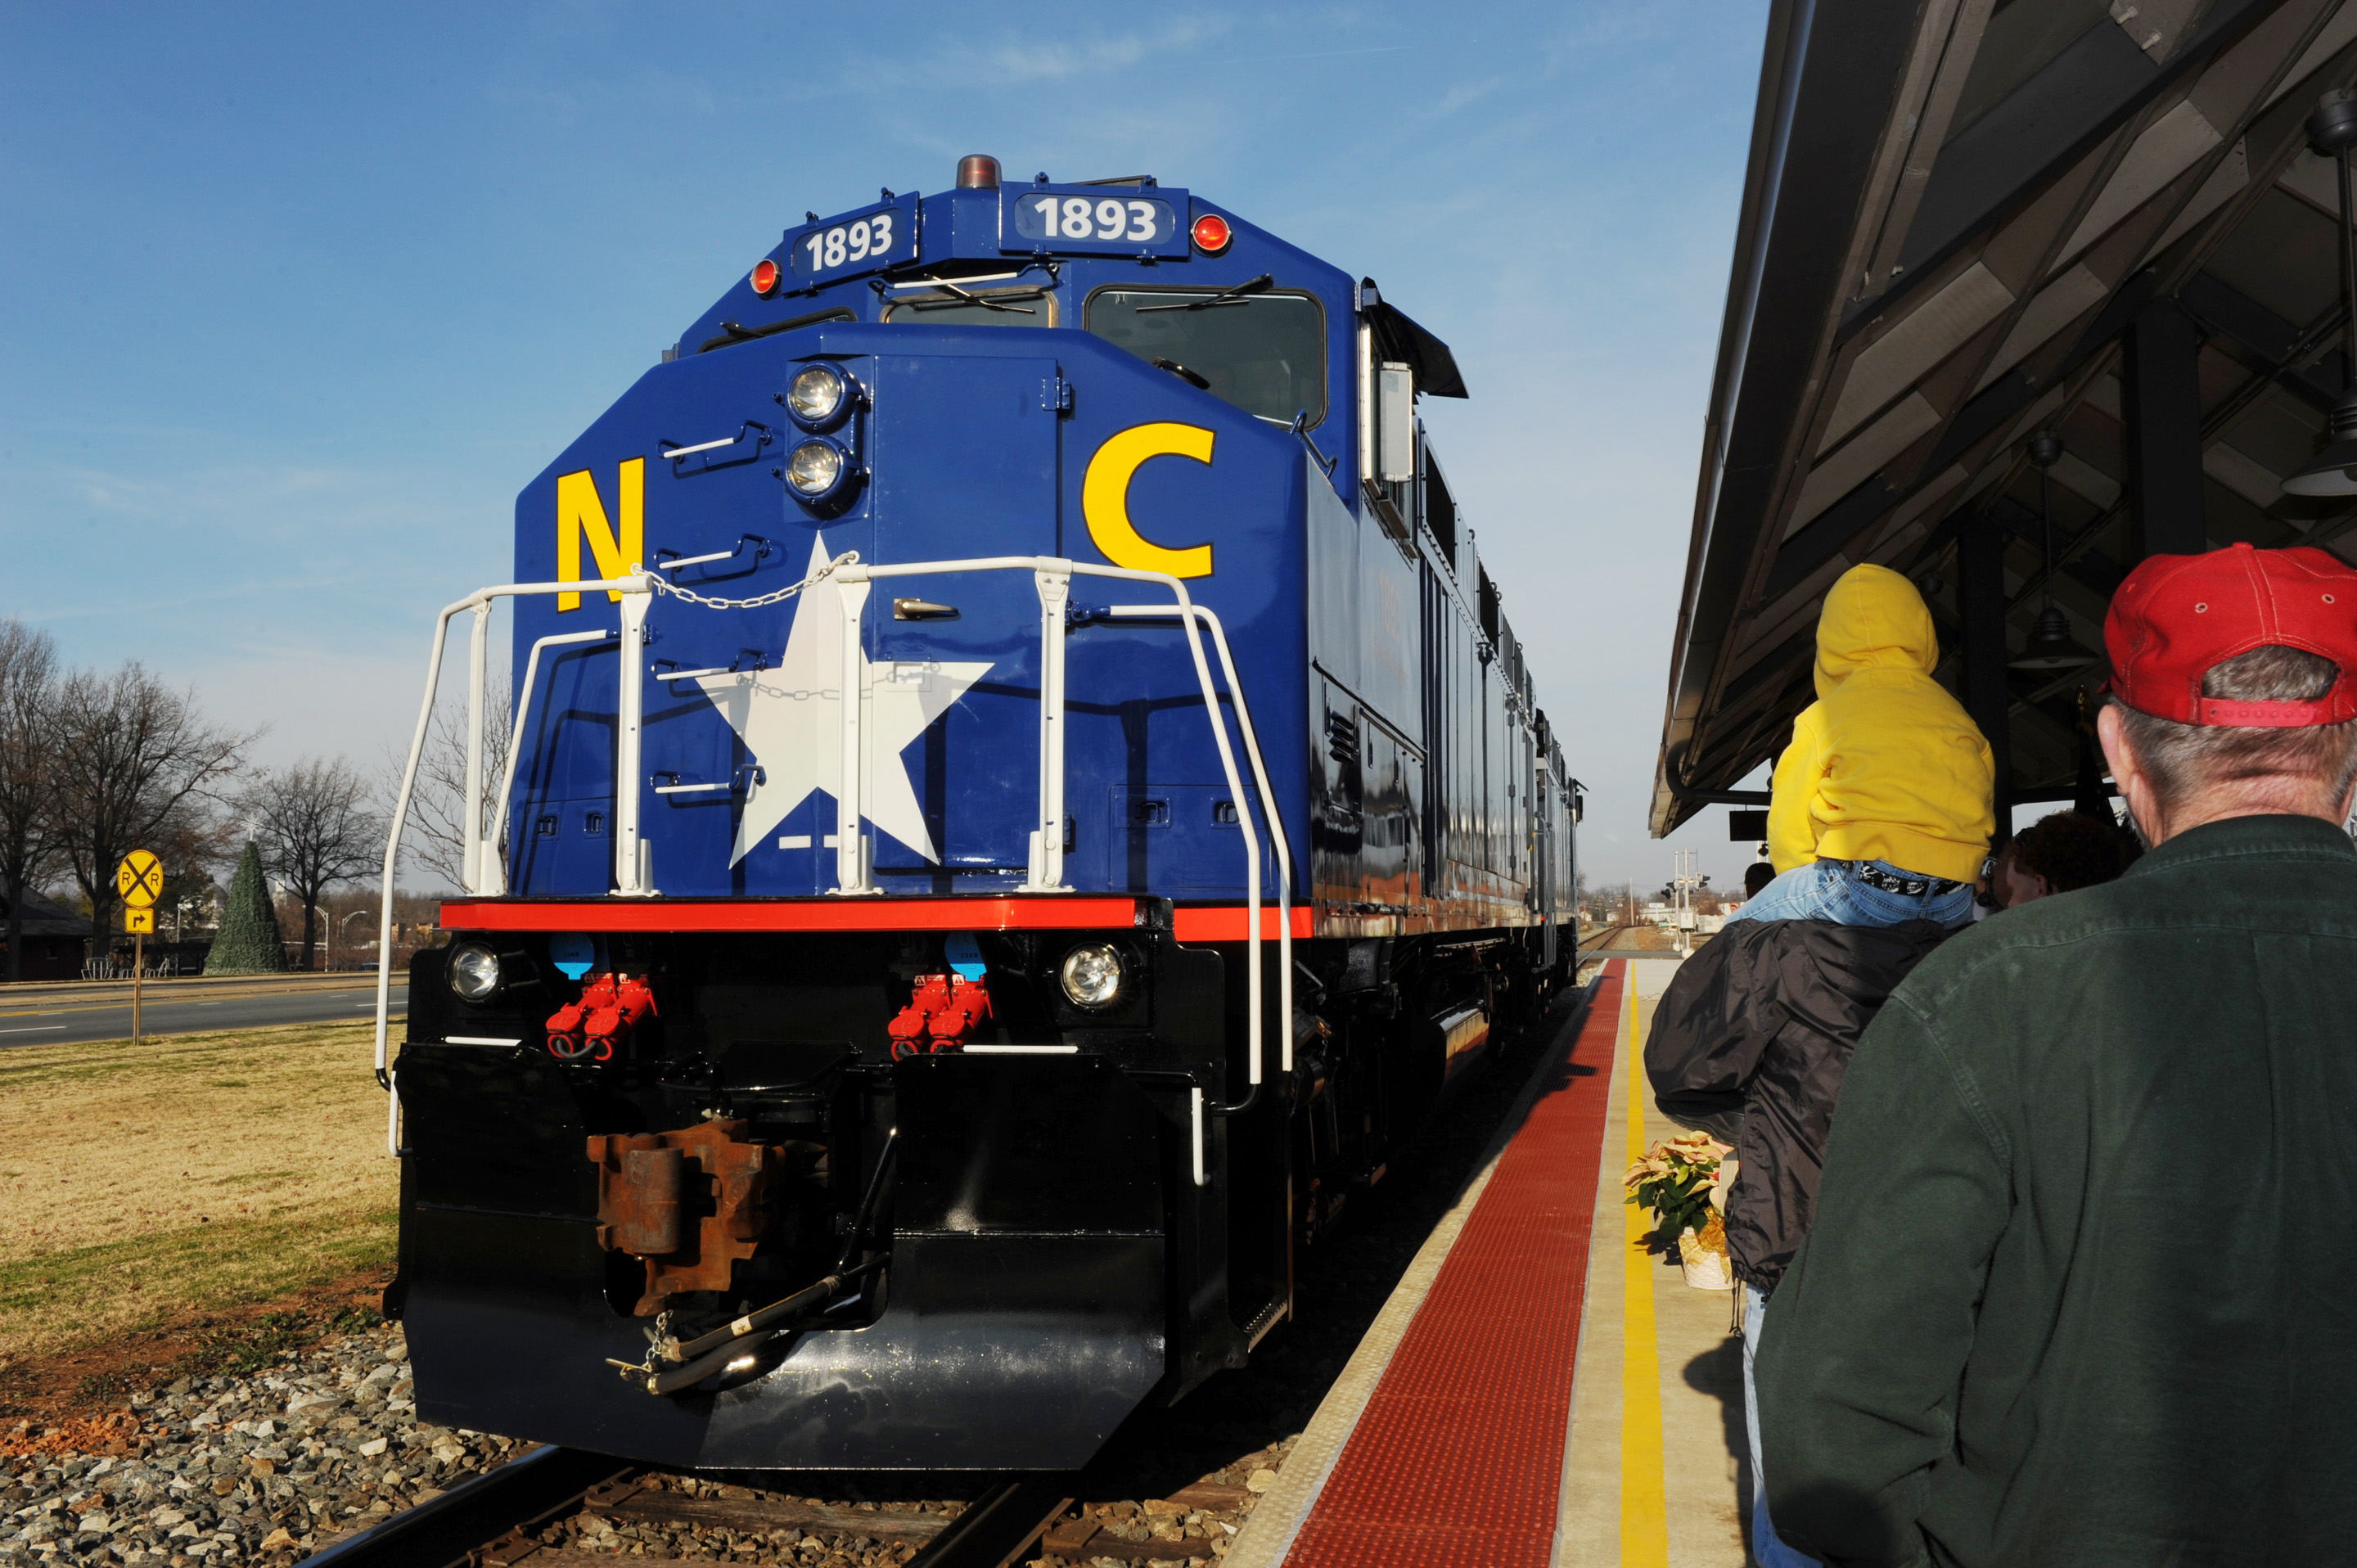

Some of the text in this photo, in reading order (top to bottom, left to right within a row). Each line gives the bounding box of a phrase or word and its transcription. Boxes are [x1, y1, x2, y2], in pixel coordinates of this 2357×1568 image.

[805, 214, 893, 272] 1893
[1034, 196, 1157, 242] 1893
[557, 420, 1217, 615] N C
[122, 872, 160, 886] R R
